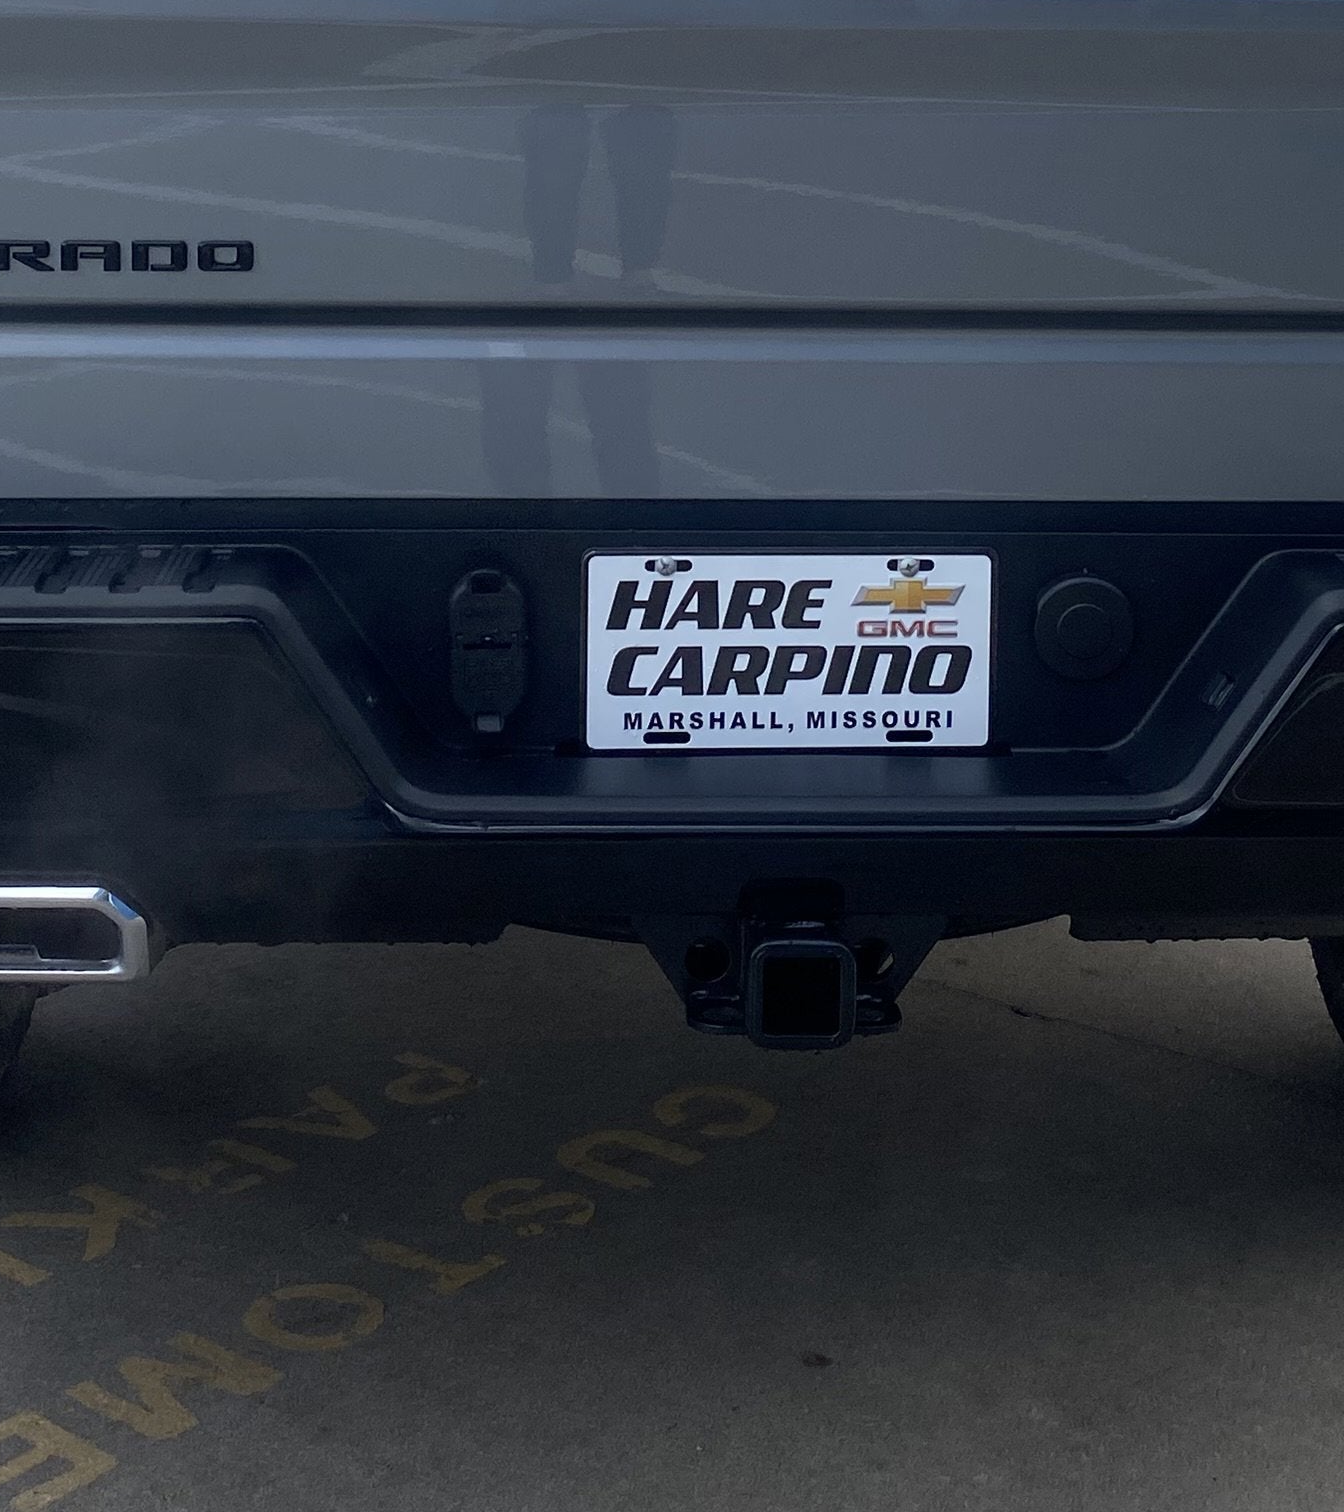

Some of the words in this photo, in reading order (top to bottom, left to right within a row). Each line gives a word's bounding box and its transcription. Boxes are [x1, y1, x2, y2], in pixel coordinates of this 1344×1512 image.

[605, 578, 832, 632] HARE
[856, 618, 959, 639] GMC
[605, 644, 973, 697] CARPINO
[623, 710, 795, 733] MARSHALL,
[806, 710, 954, 731] MISSOURI
